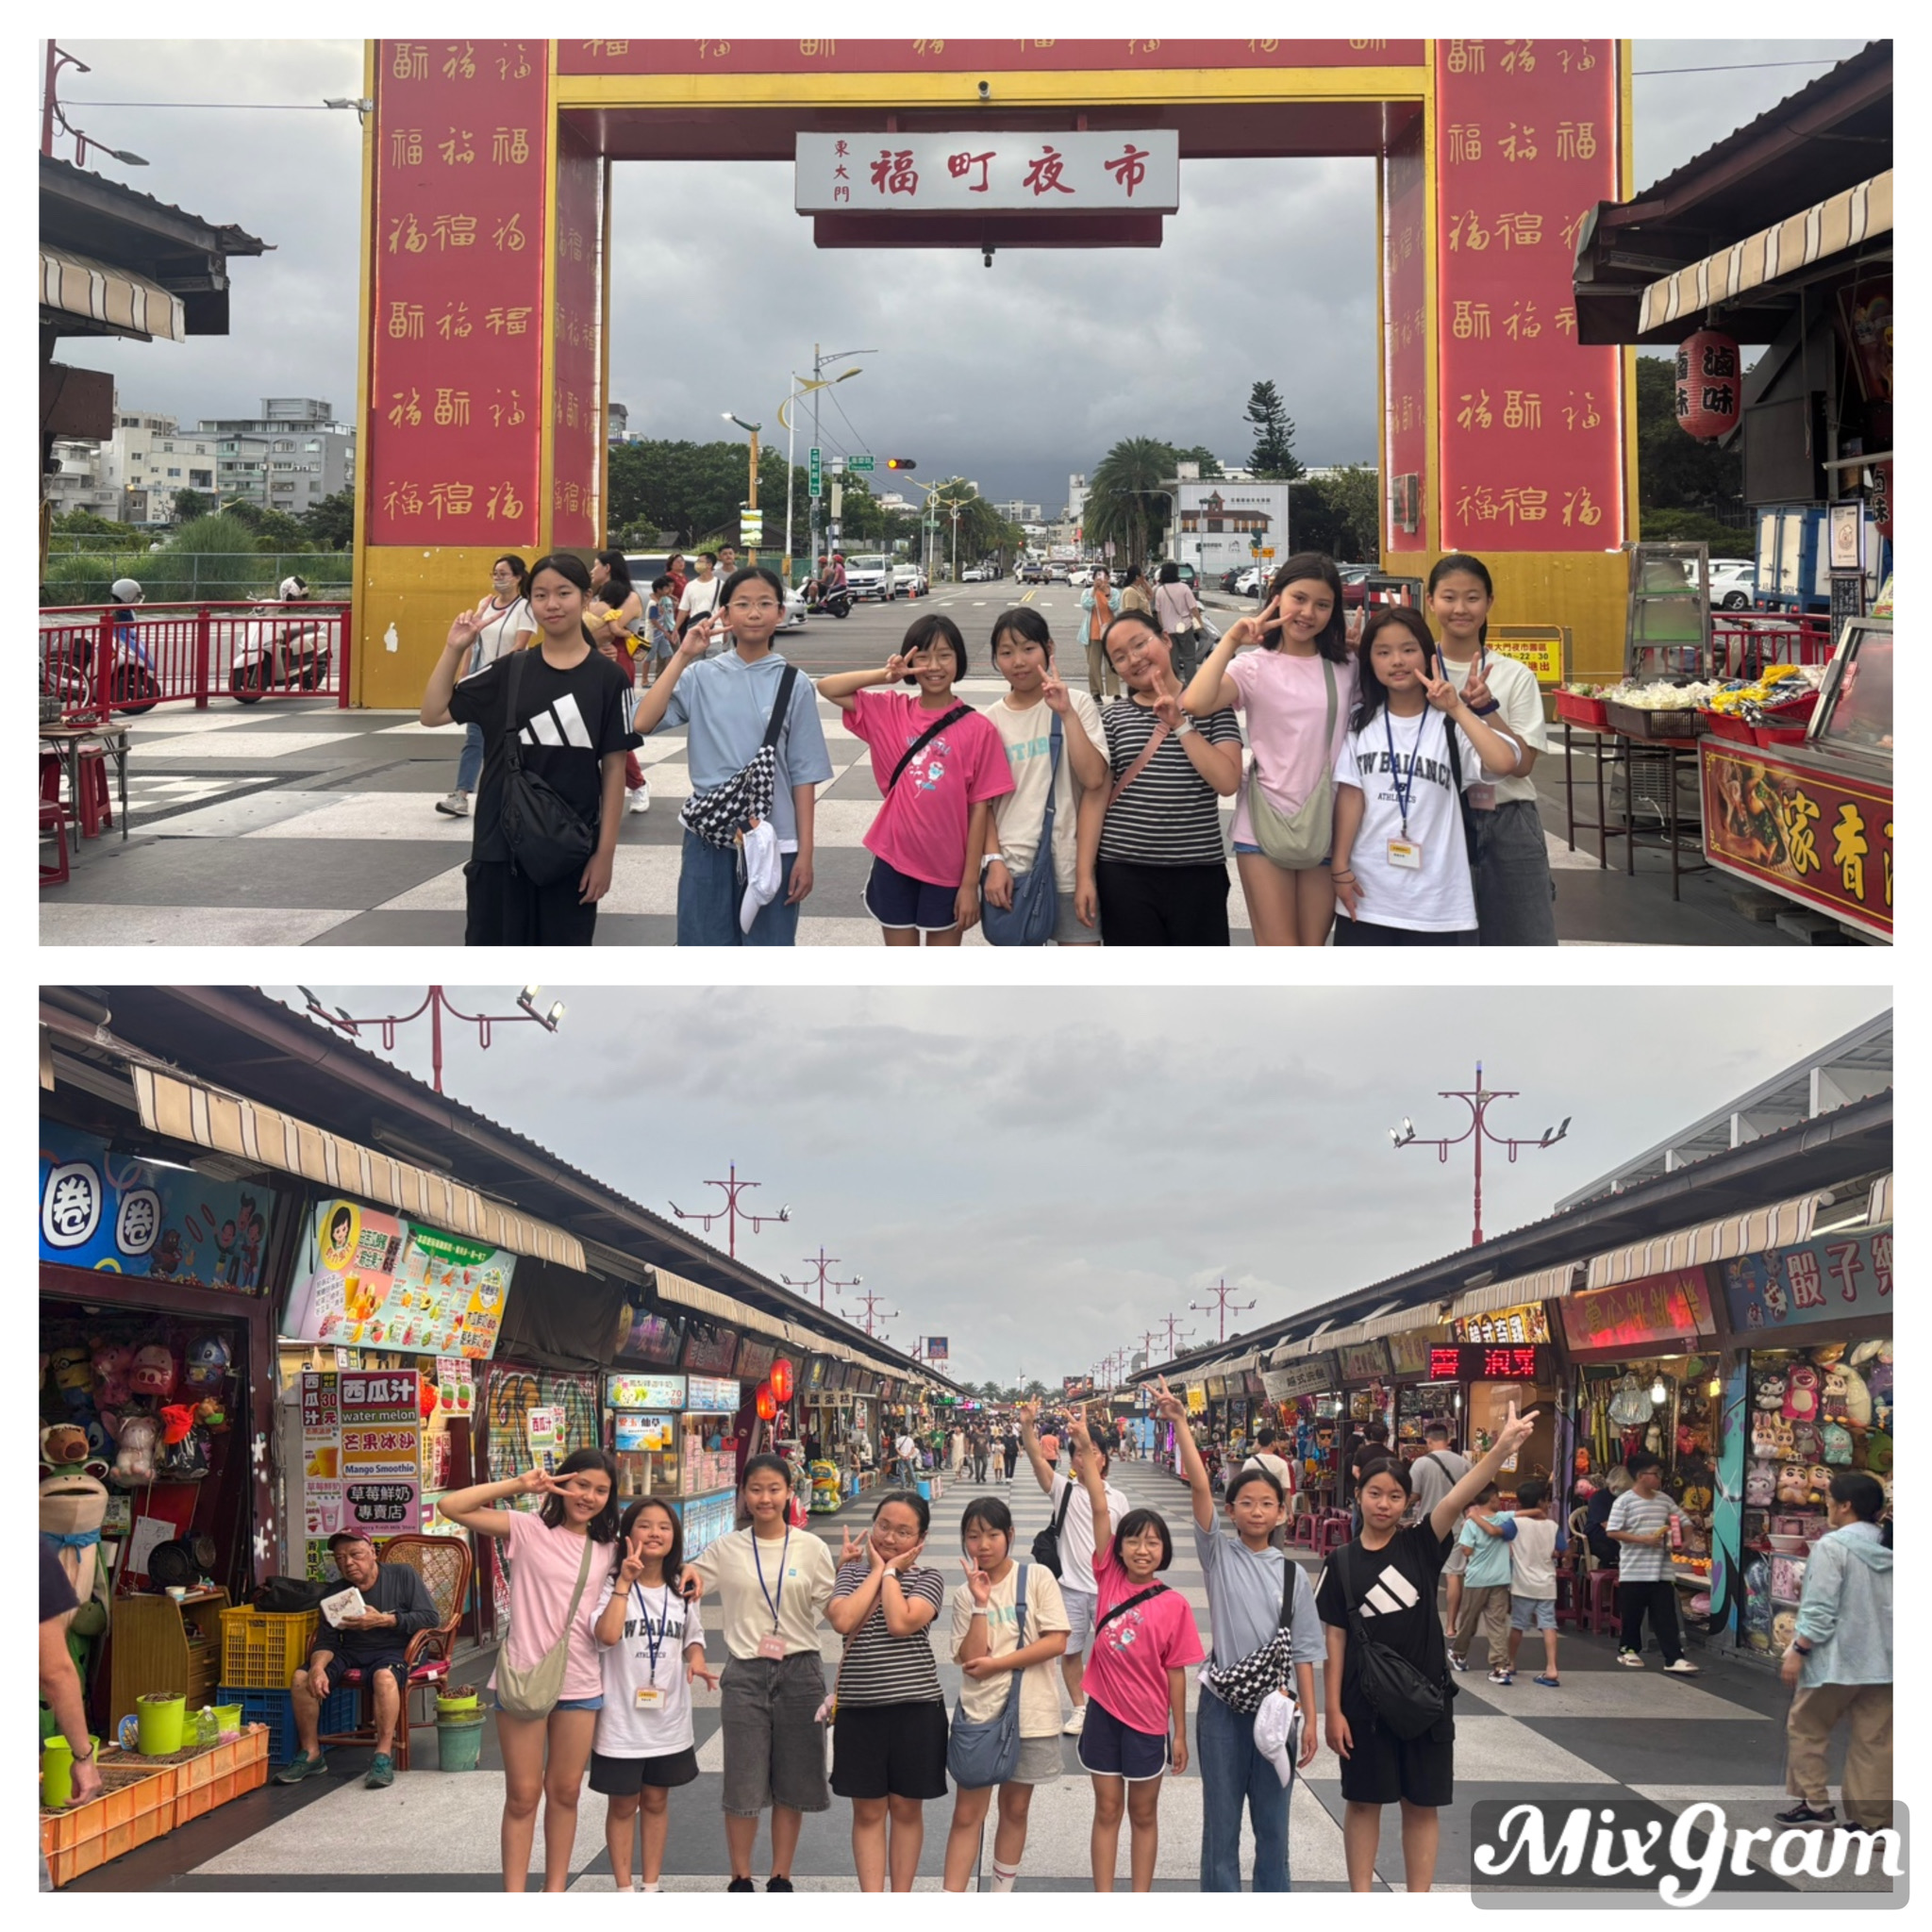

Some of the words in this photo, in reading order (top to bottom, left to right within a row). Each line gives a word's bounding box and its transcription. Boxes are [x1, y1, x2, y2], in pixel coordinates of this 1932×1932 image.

[834, 140, 849, 202] 東大門
[870, 143, 1150, 197] 福町夜市
[1703, 345, 1734, 414] 滷味
[304, 1374, 320, 1424] 西瓜汁
[342, 1378, 415, 1404] 西瓜汁
[321, 1393, 338, 1408] 30
[324, 1410, 337, 1424] 元
[342, 1411, 375, 1423] water
[379, 1409, 415, 1421] melon
[532, 1416, 552, 1432] 西瓜汁
[343, 1431, 416, 1451] 芒果冰沙
[345, 1465, 375, 1475] Mango
[375, 1464, 415, 1474] Smoothie
[350, 1486, 410, 1501] 草莓鮮奶
[358, 1505, 404, 1520] 專賣店
